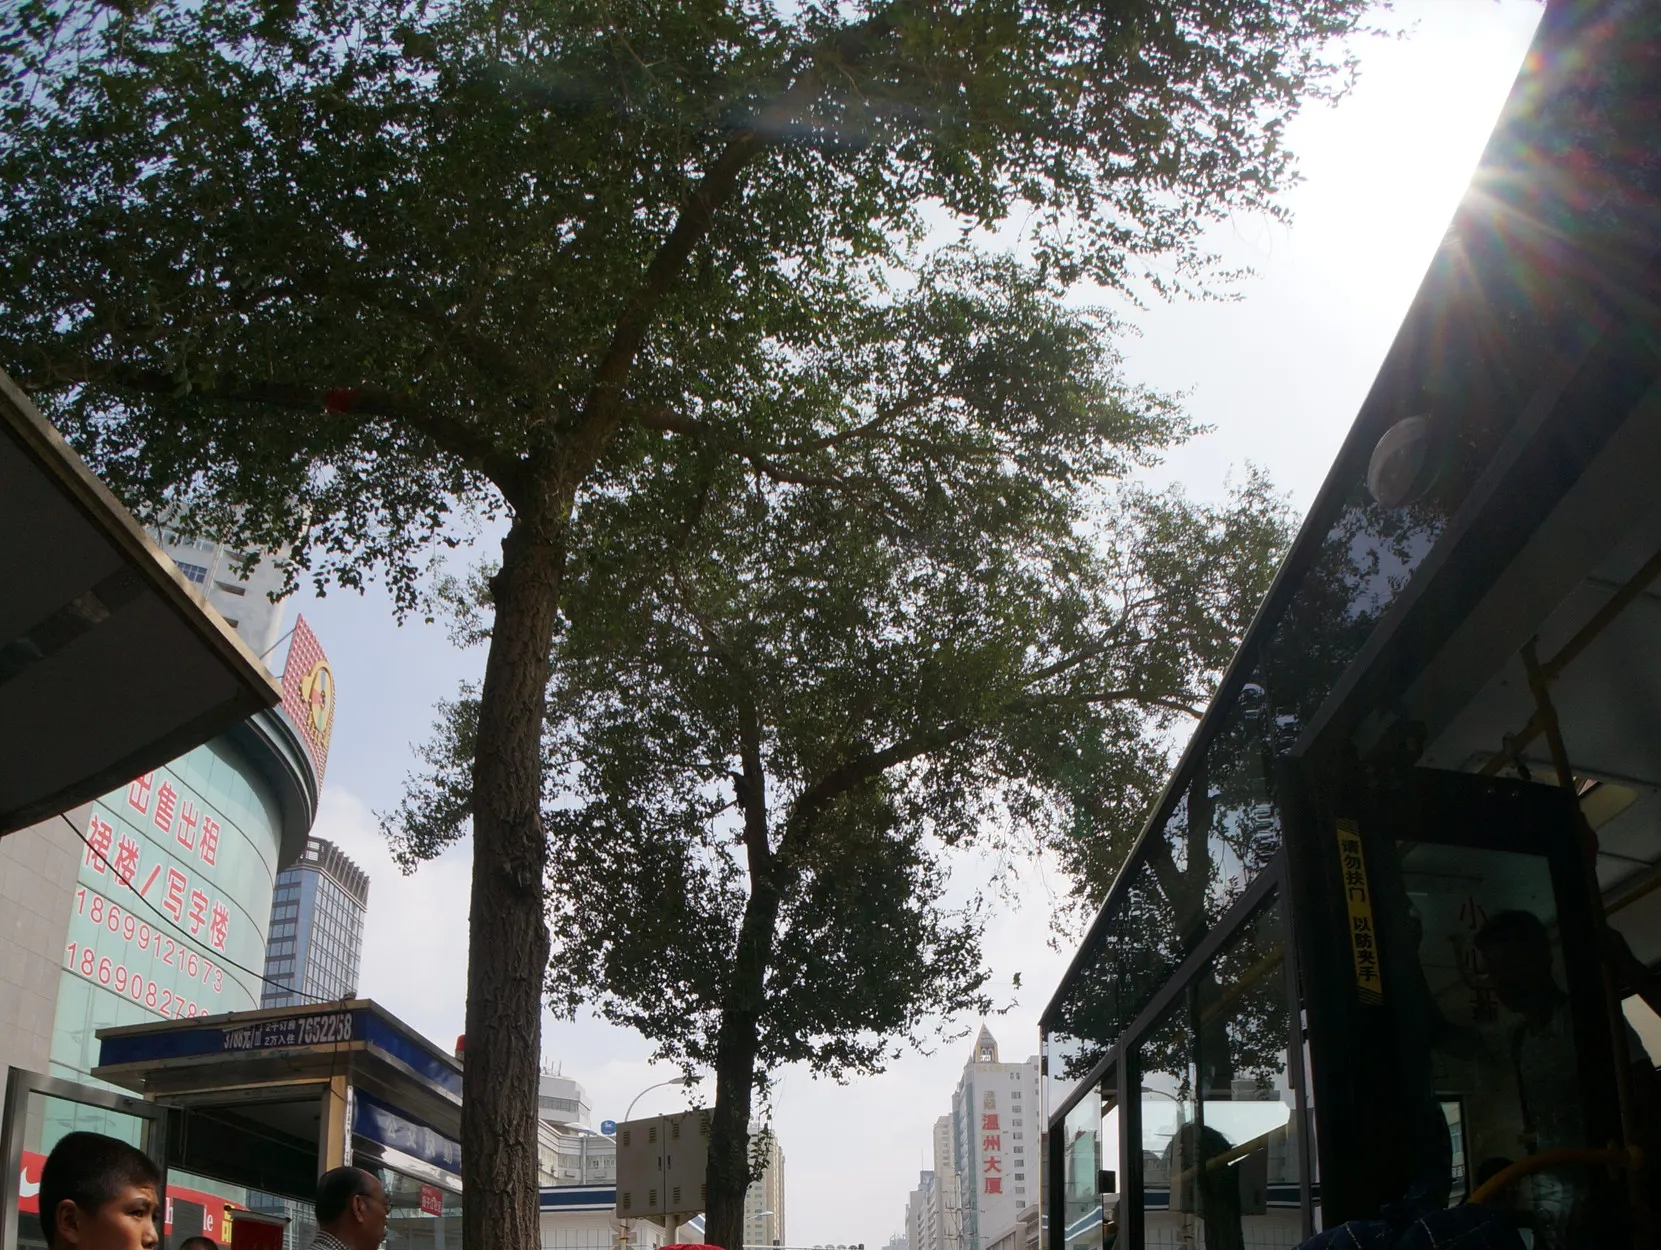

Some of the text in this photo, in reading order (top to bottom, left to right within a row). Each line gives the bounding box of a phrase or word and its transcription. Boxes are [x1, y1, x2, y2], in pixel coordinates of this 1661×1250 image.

[75, 887, 224, 993] 18699121673
[1353, 916, 1378, 982] 以防夹手
[982, 1113, 1004, 1194] 温州大厦
